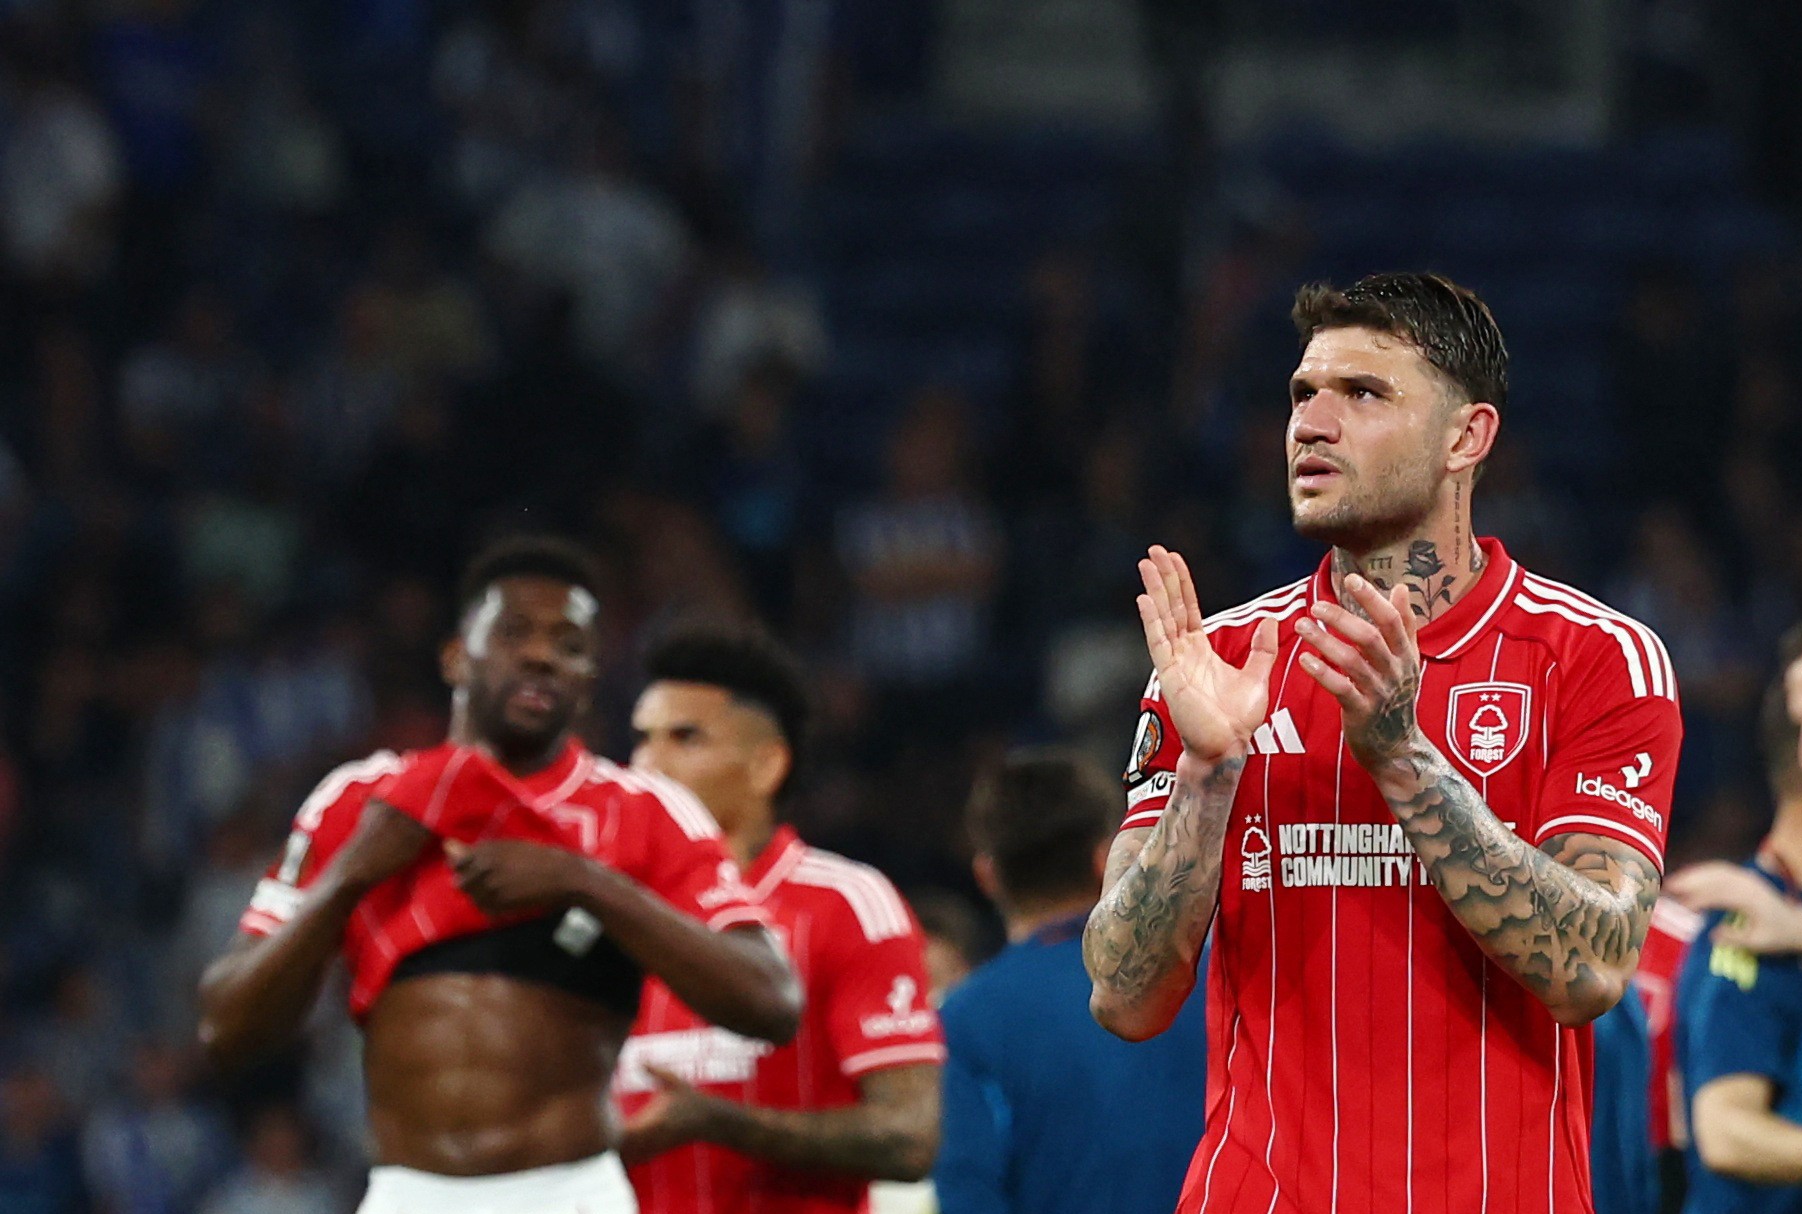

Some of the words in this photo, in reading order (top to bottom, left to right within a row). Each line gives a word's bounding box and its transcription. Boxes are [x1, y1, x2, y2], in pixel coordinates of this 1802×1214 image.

[1576, 772, 1663, 832] Ideagen
[1278, 823, 1416, 855] NOTTINGHA
[1281, 856, 1413, 888] COMMUNITY
